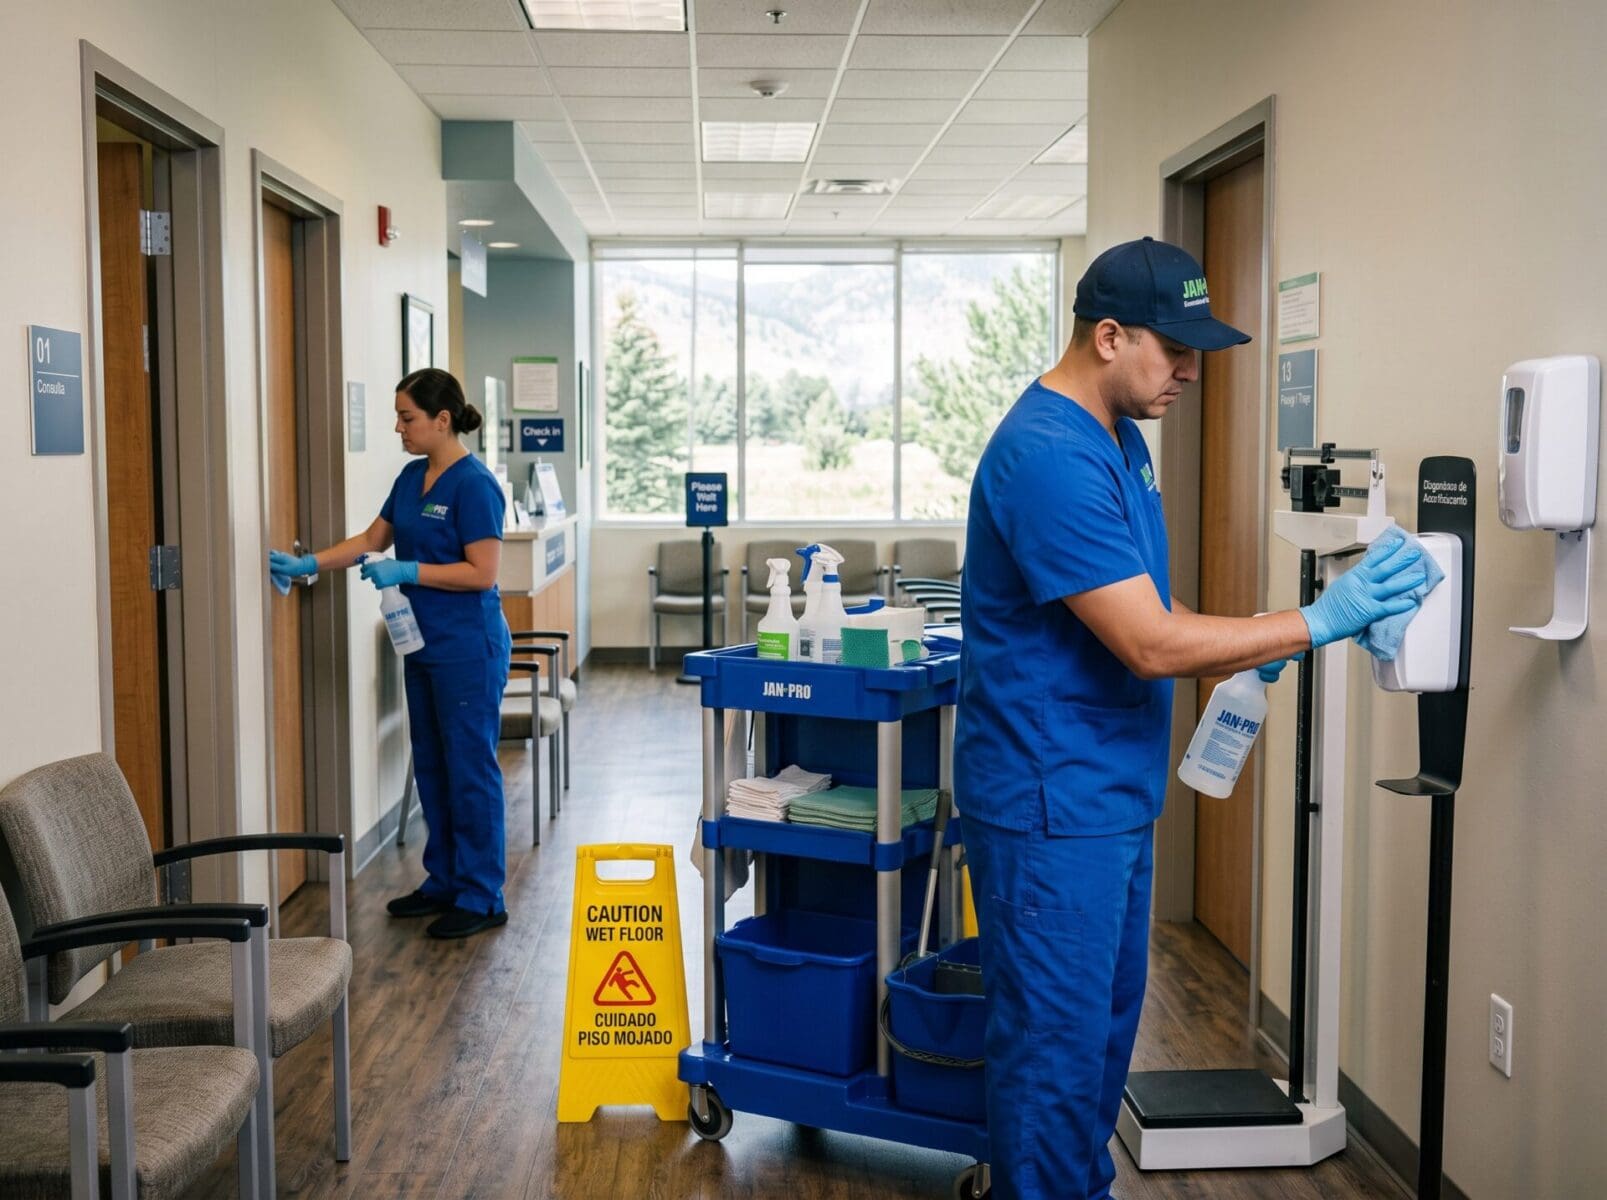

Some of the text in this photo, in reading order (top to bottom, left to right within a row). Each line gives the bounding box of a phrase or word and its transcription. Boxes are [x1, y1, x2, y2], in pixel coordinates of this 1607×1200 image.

[36, 336, 50, 364] 01
[1282, 361, 1292, 383] 13
[523, 426, 561, 436] Check in
[691, 481, 722, 492] Please
[1458, 481, 1467, 492] de
[695, 502, 718, 512] Here
[587, 905, 663, 922] CAUTION
[586, 927, 663, 941] WET FLOOR
[594, 1013, 656, 1027] CUIDADO
[578, 1031, 672, 1045] PISO MOJADO
